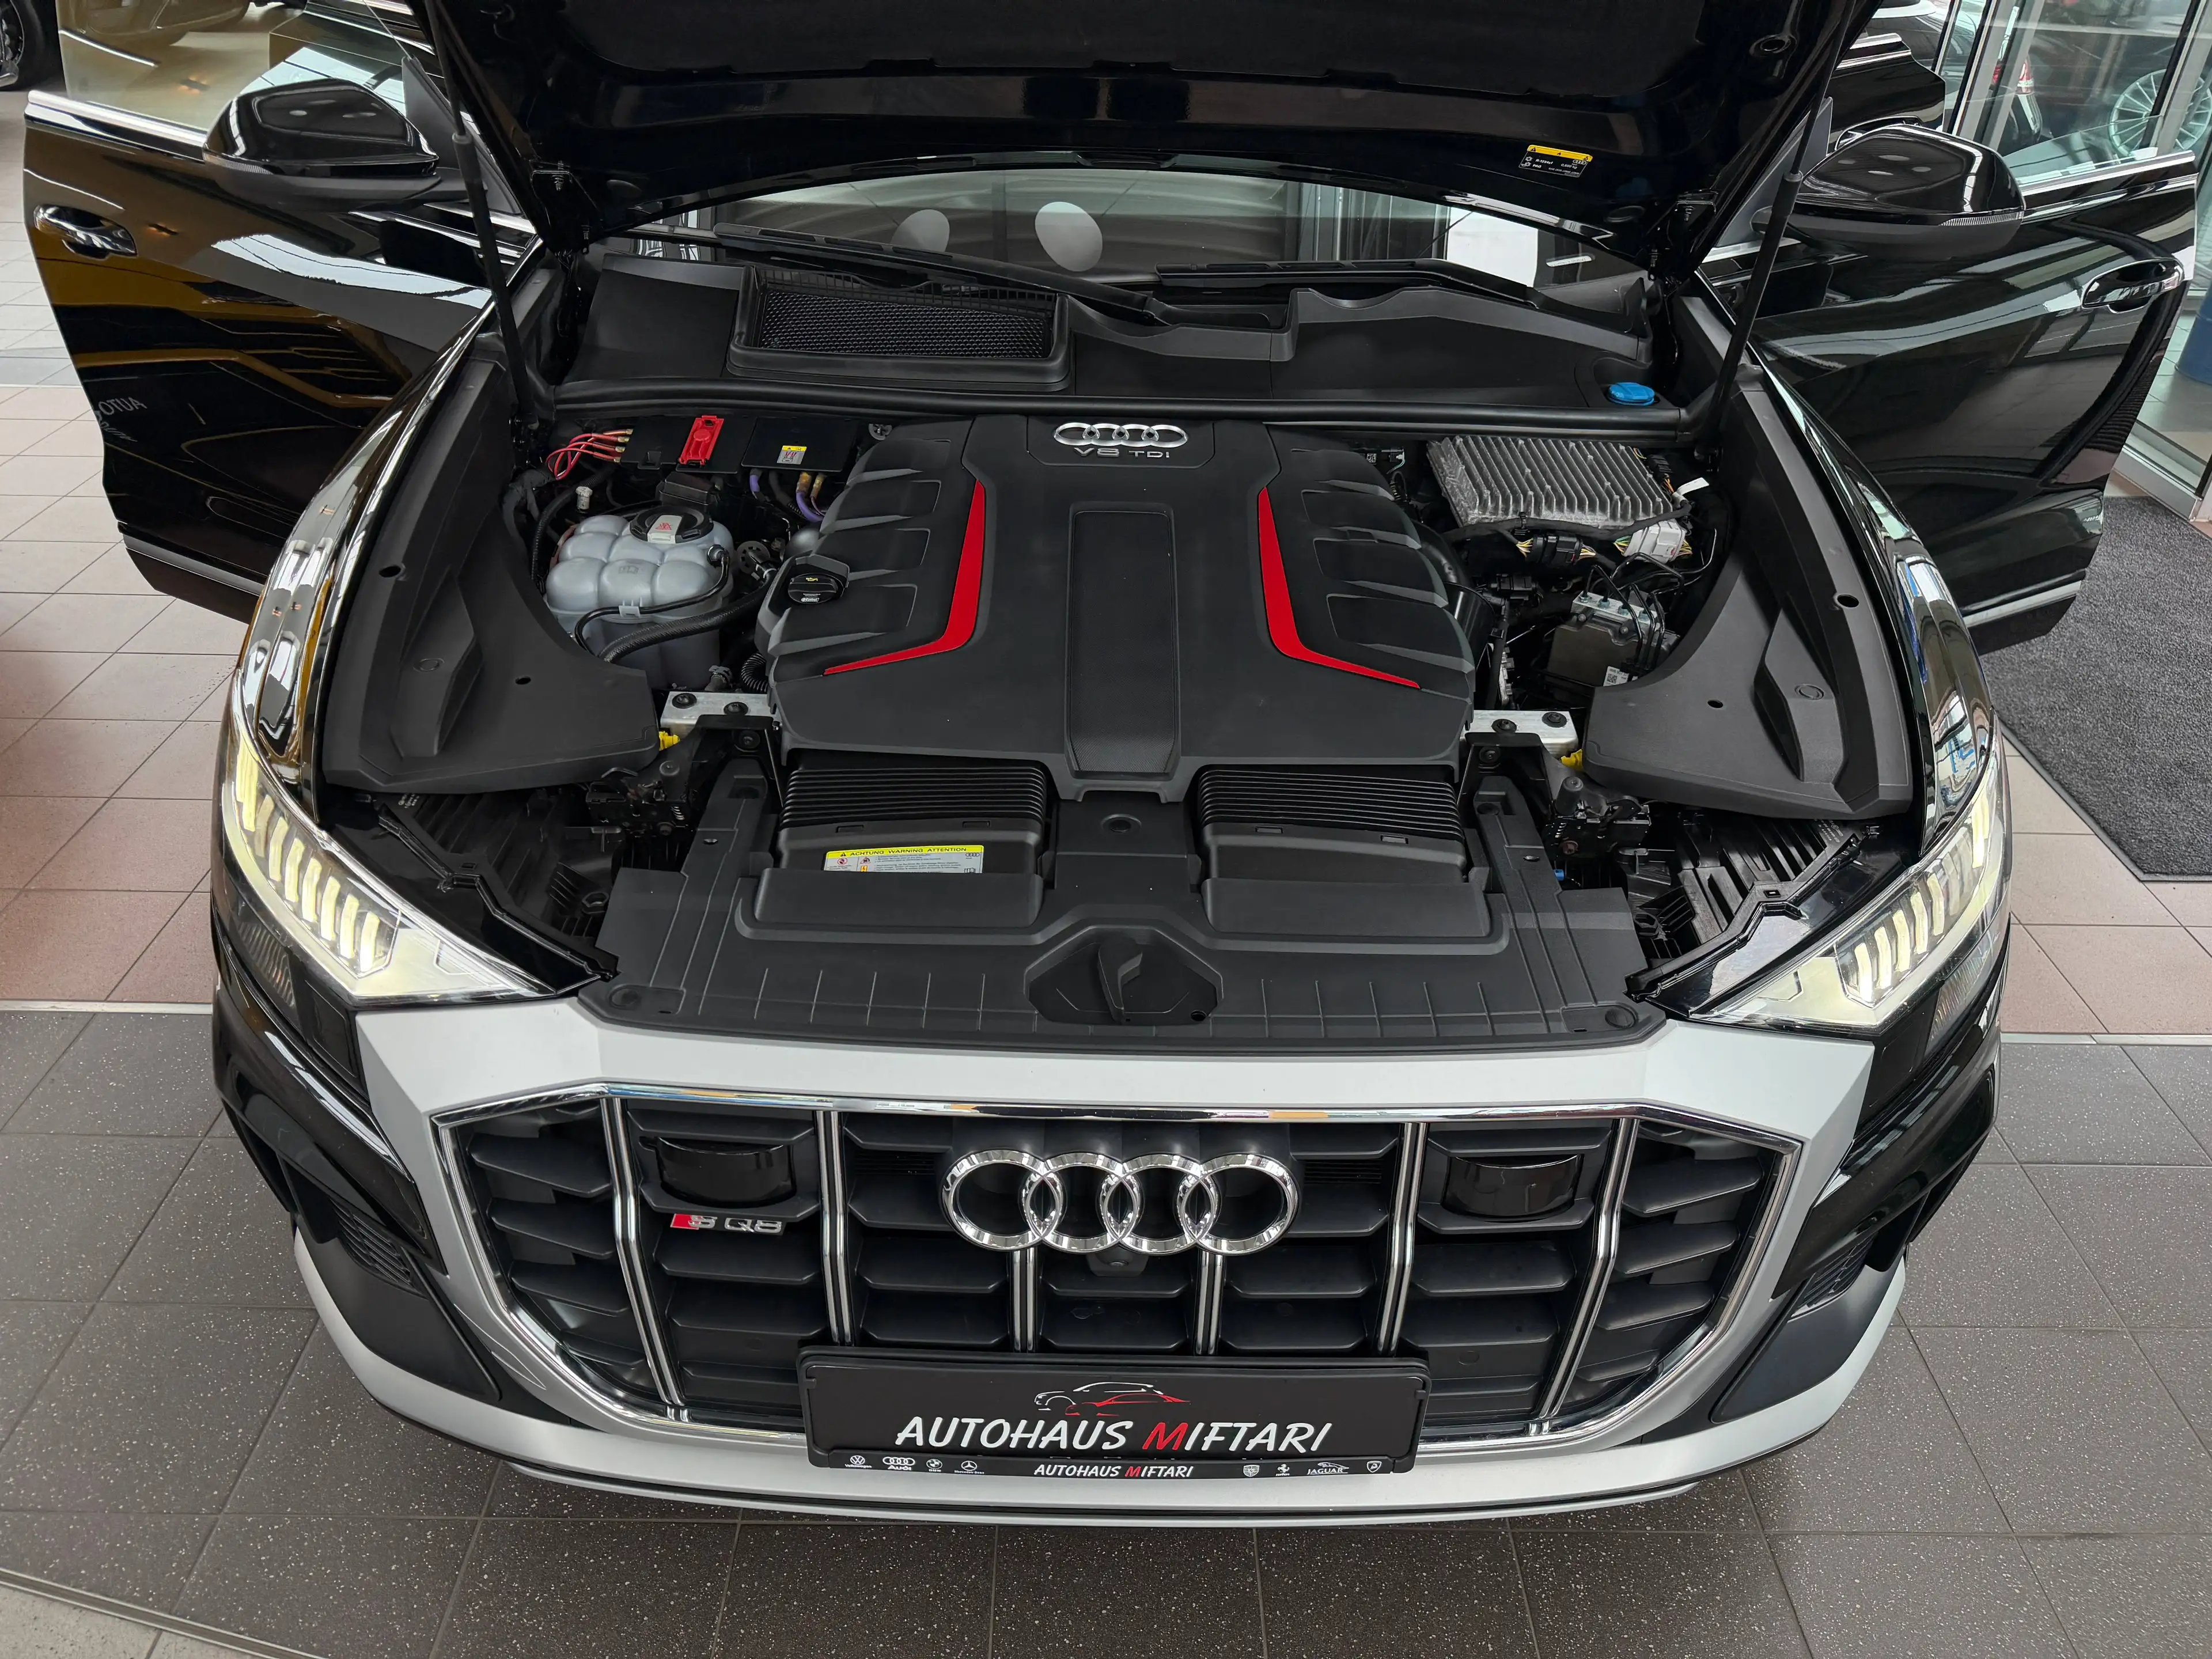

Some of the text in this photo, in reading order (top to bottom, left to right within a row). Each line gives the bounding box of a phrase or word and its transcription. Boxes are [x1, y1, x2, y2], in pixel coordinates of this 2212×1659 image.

[1074, 448, 1119, 457] V8
[895, 1416, 1332, 1452] AUTOHAUS MIFTARI
[1034, 1464, 1195, 1478] AUTOHAUS MIFTARI
